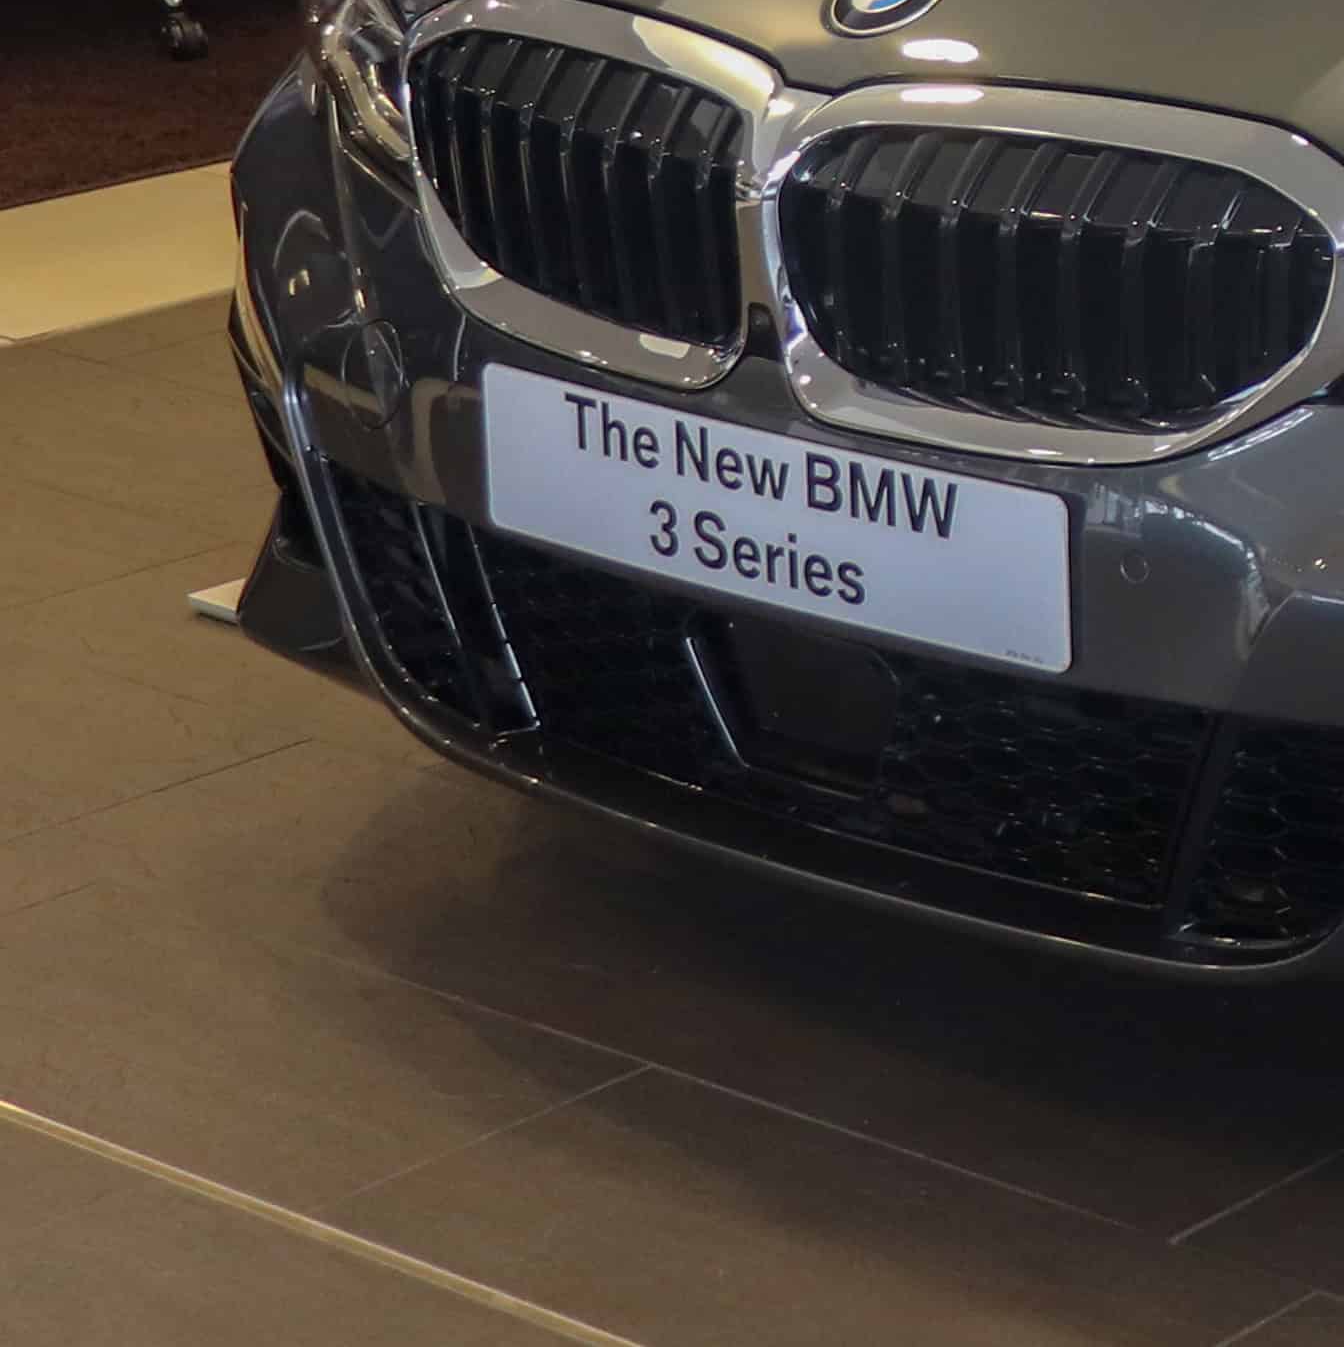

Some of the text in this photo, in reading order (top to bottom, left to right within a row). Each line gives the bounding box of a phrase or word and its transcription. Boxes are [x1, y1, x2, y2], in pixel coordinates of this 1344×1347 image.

[563, 390, 959, 539] The New BMW
[648, 500, 868, 606] 3 Series
